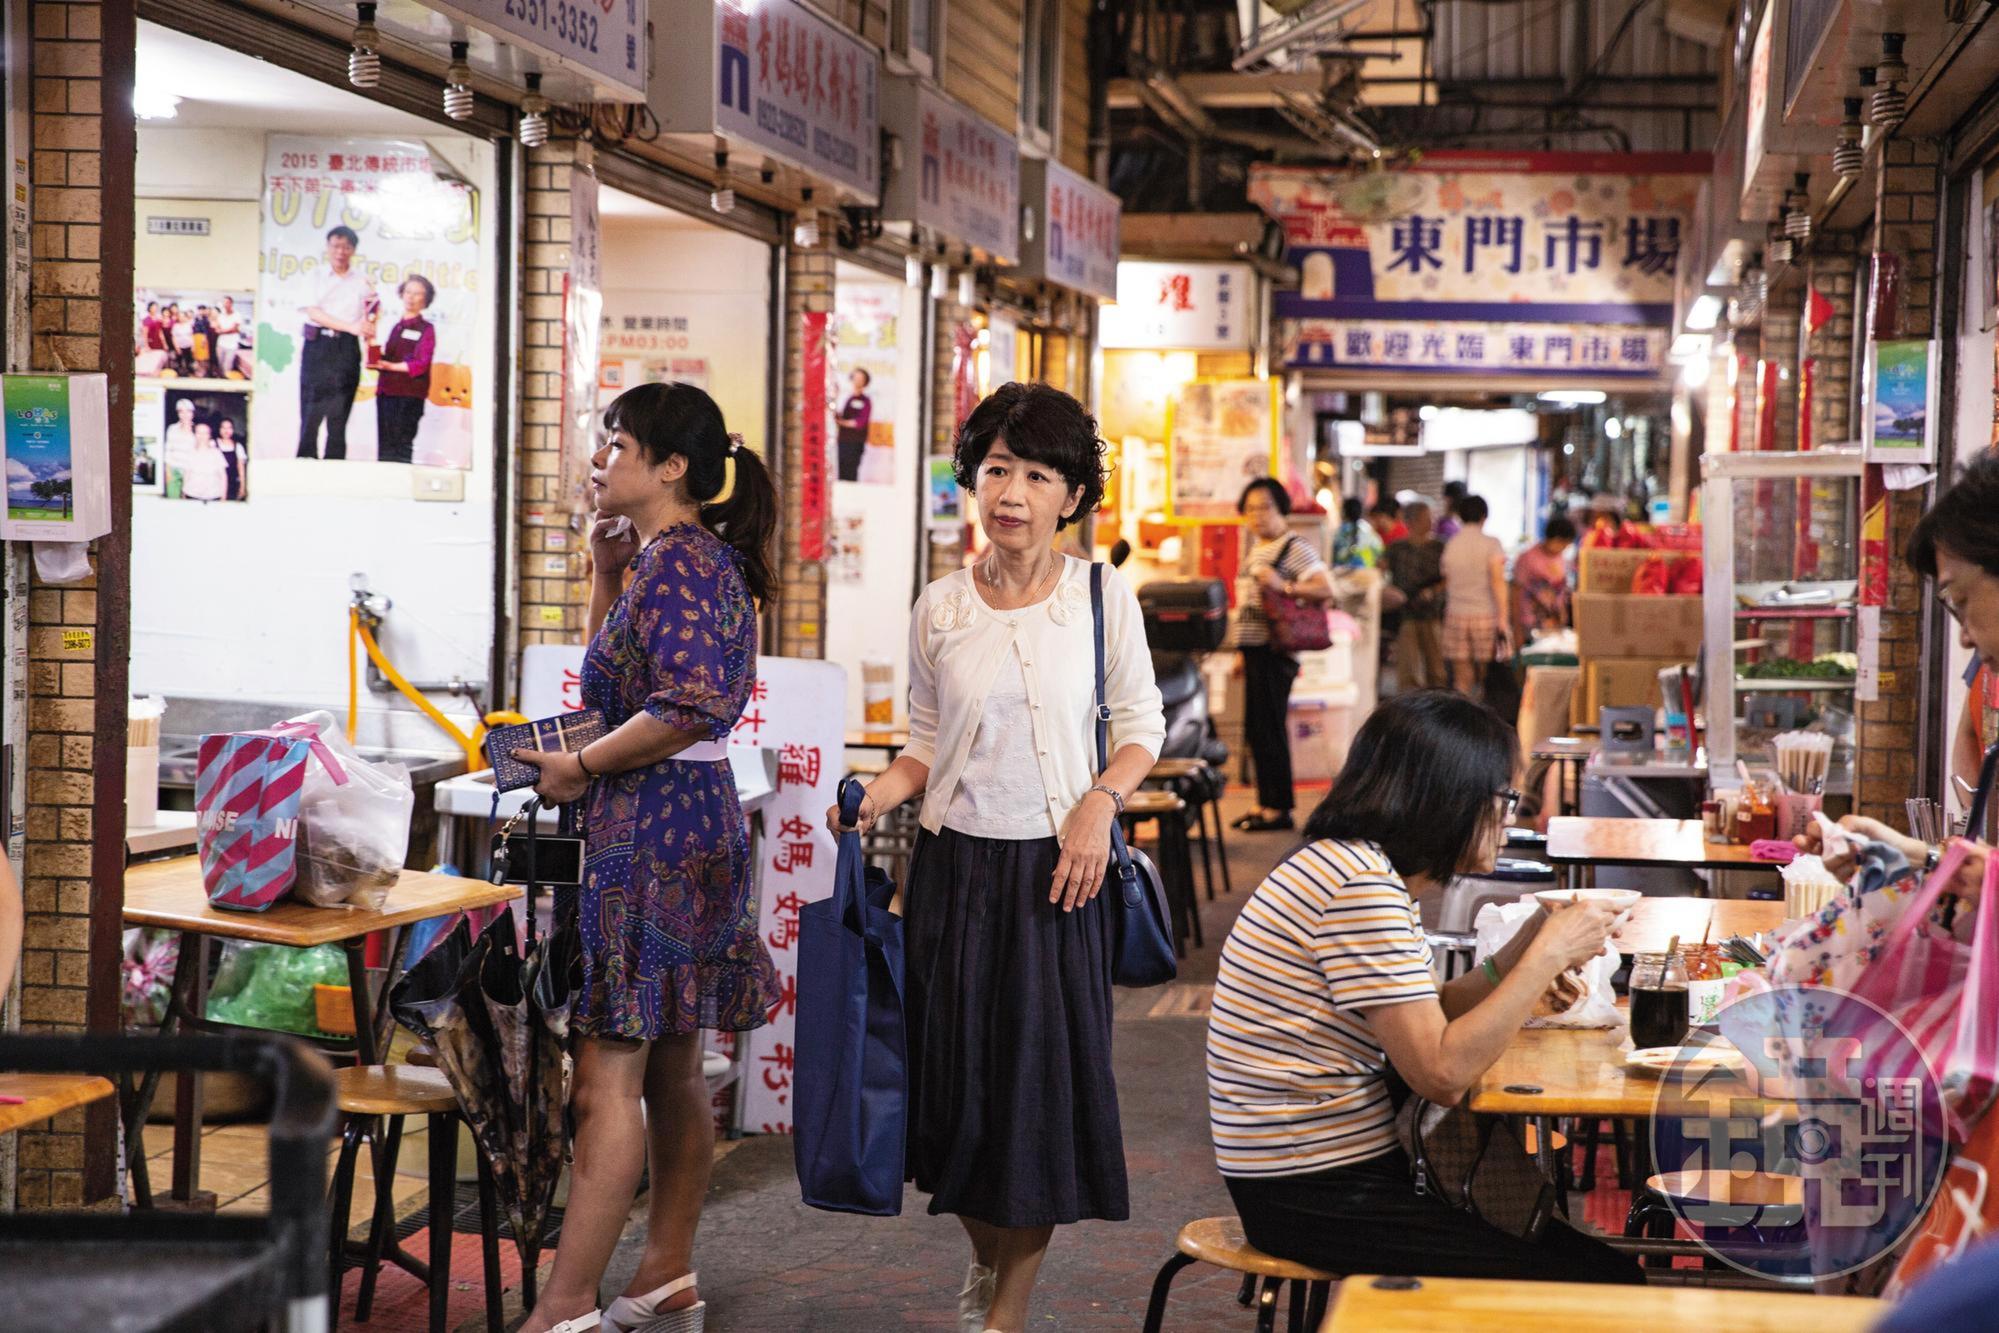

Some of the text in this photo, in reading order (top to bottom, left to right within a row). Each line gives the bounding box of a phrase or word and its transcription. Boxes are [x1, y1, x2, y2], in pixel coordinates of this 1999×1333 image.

[281, 153, 318, 169] 2015
[1386, 215, 1680, 276] 東門市場
[624, 317, 688, 331] 營業時間
[1346, 330, 1649, 362] 歡迎光臨 東門市場
[760, 744, 821, 1136] 羅媽媽米粉
